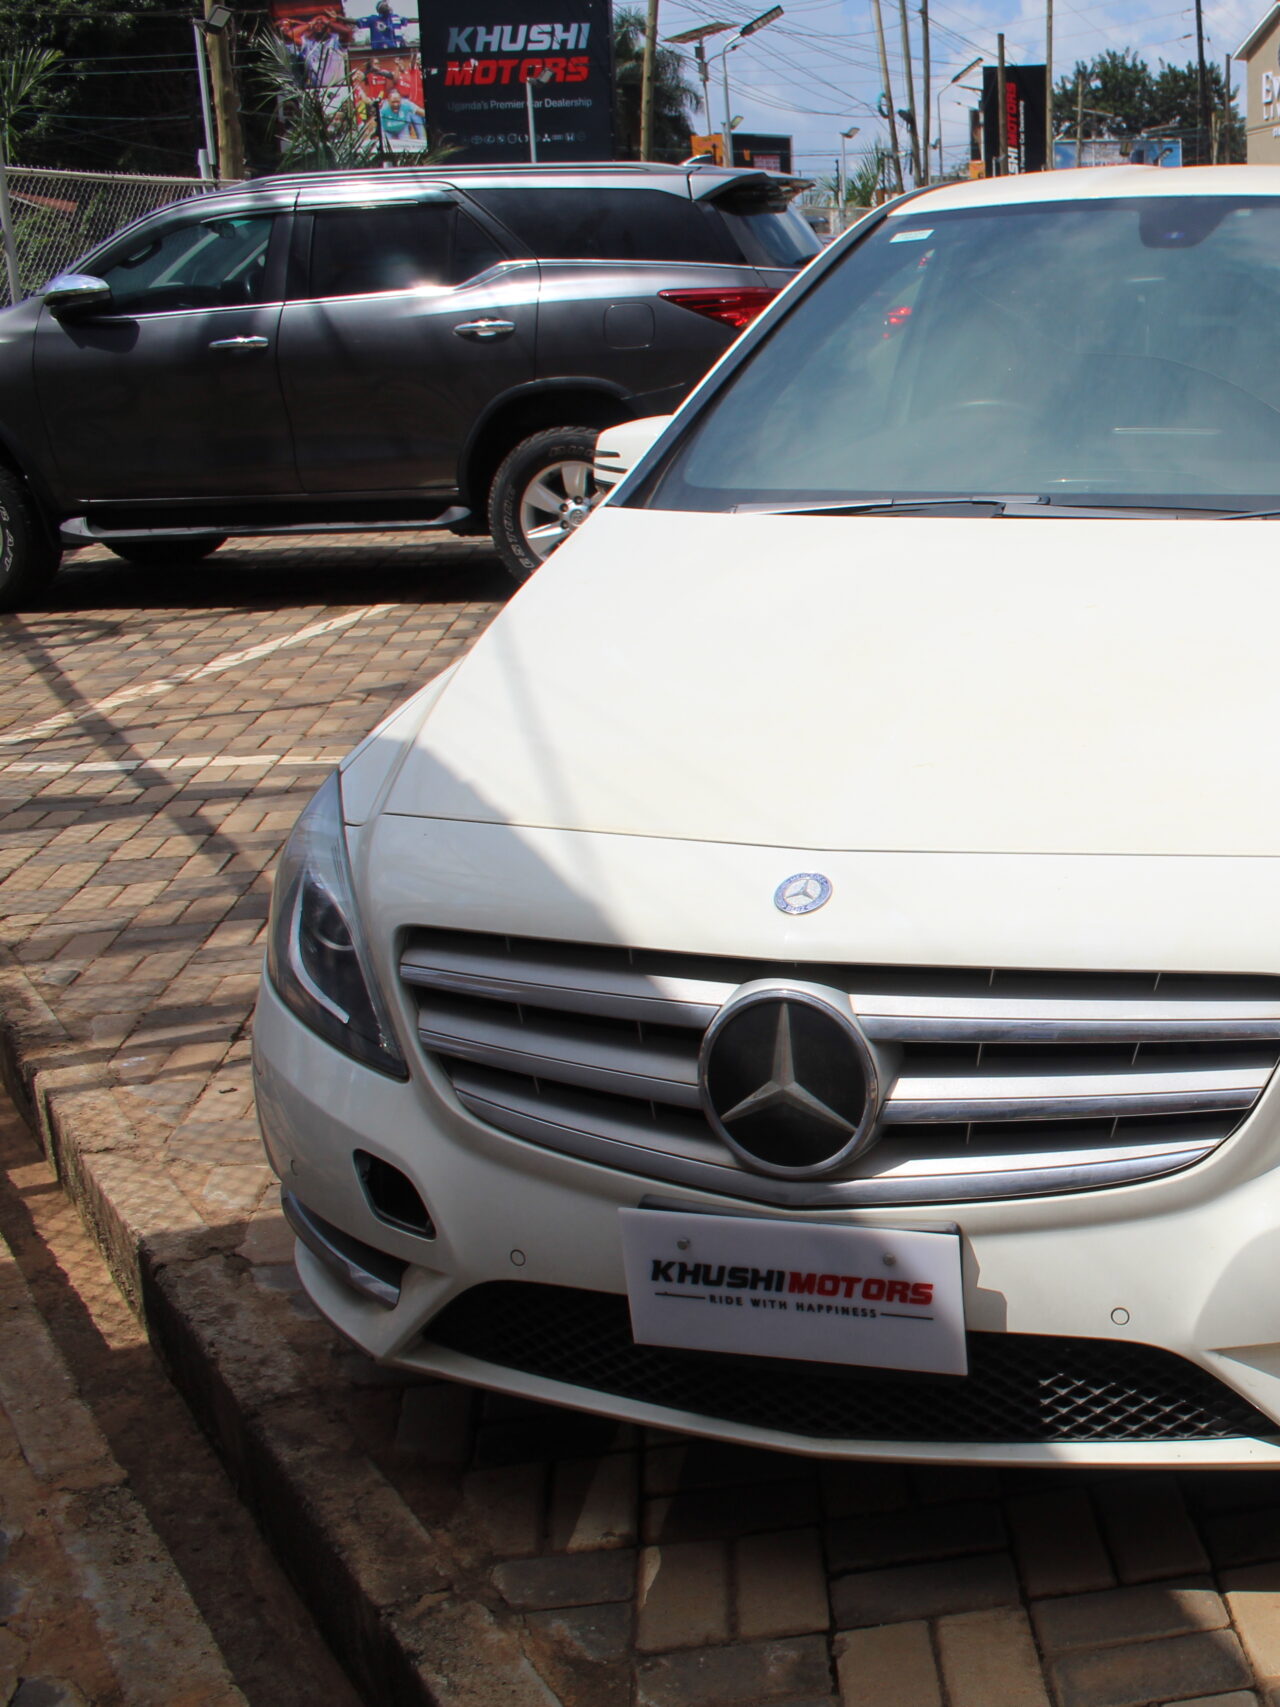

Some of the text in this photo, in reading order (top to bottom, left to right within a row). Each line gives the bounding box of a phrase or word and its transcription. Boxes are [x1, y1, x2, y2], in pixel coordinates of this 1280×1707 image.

[447, 23, 591, 53] KHUSHI
[444, 56, 590, 86] MOTORS
[490, 99, 525, 110] Premier
[544, 97, 593, 110] Dealership
[709, 1294, 877, 1319] RIDE WITH HAPPINESS
